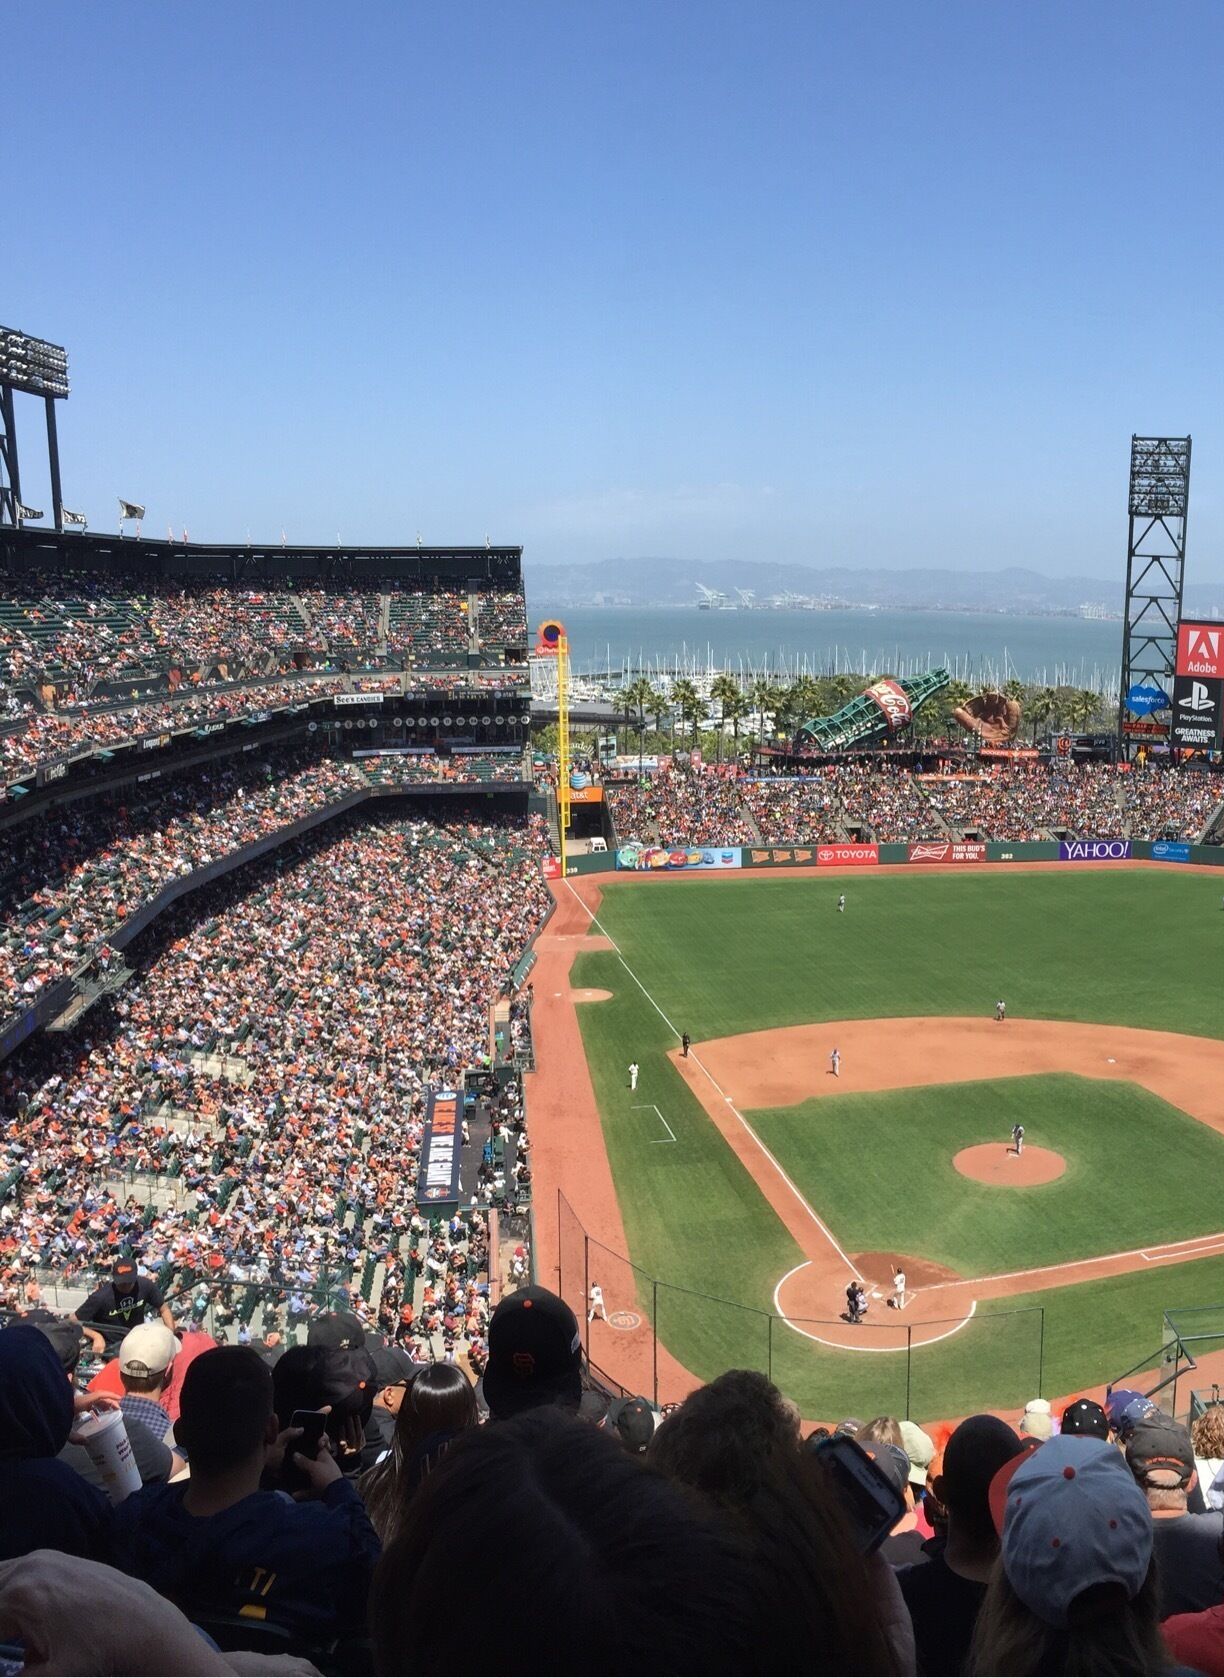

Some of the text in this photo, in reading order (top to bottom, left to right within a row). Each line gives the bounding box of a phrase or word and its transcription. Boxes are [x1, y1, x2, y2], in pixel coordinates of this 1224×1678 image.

[1187, 661, 1217, 674] Adobe
[1131, 695, 1164, 704] salesforce
[1179, 714, 1212, 722] PlayStation
[1174, 728, 1215, 738] GREATNESS
[1180, 735, 1209, 744] AWAITS
[570, 790, 588, 800] at&t
[835, 850, 878, 860] TOYOTA
[1064, 842, 1129, 859] YAHOO!
[952, 852, 979, 860] FOR YOU.
